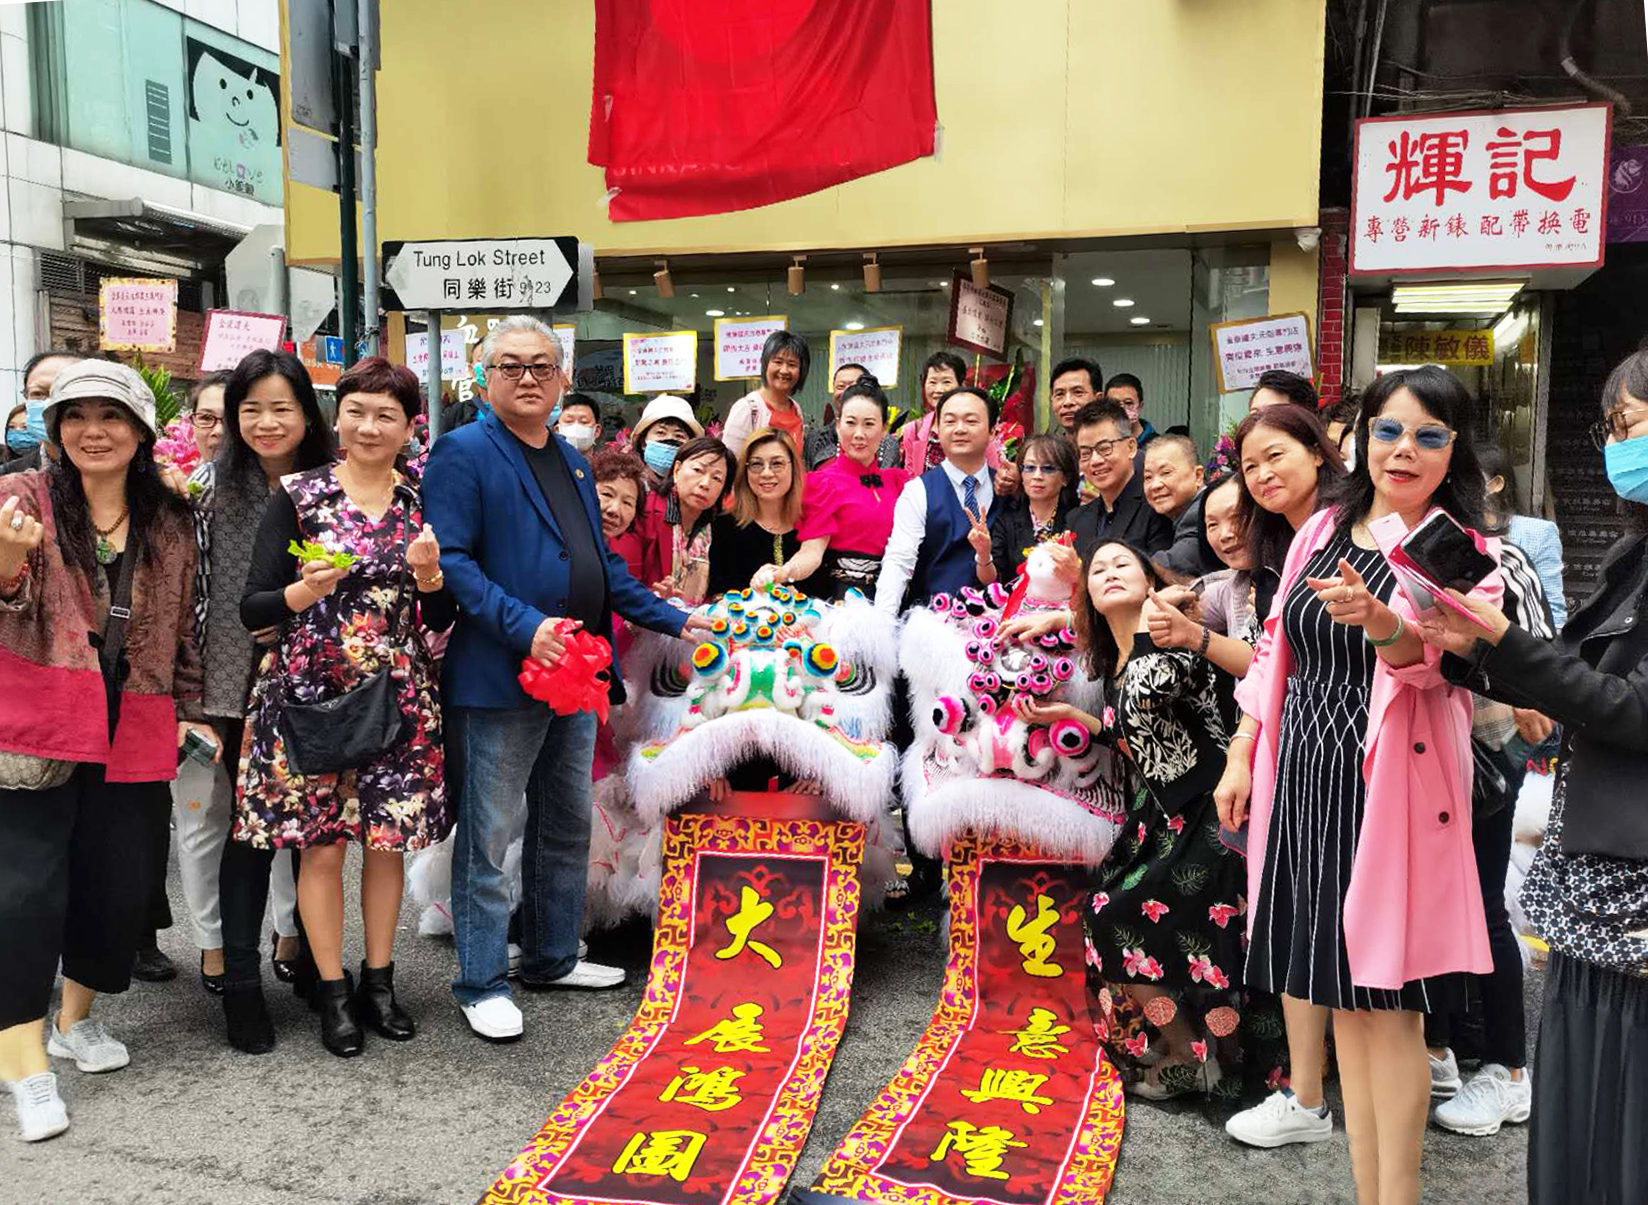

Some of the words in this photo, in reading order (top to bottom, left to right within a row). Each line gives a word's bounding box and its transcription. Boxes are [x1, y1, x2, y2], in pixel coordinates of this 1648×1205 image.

[1383, 127, 1577, 206] 輝記
[413, 250, 451, 270] Tung
[456, 250, 486, 267] Lok
[493, 248, 545, 266] Street
[443, 278, 513, 300] 同樂街
[1405, 334, 1490, 361] 陳敏儀
